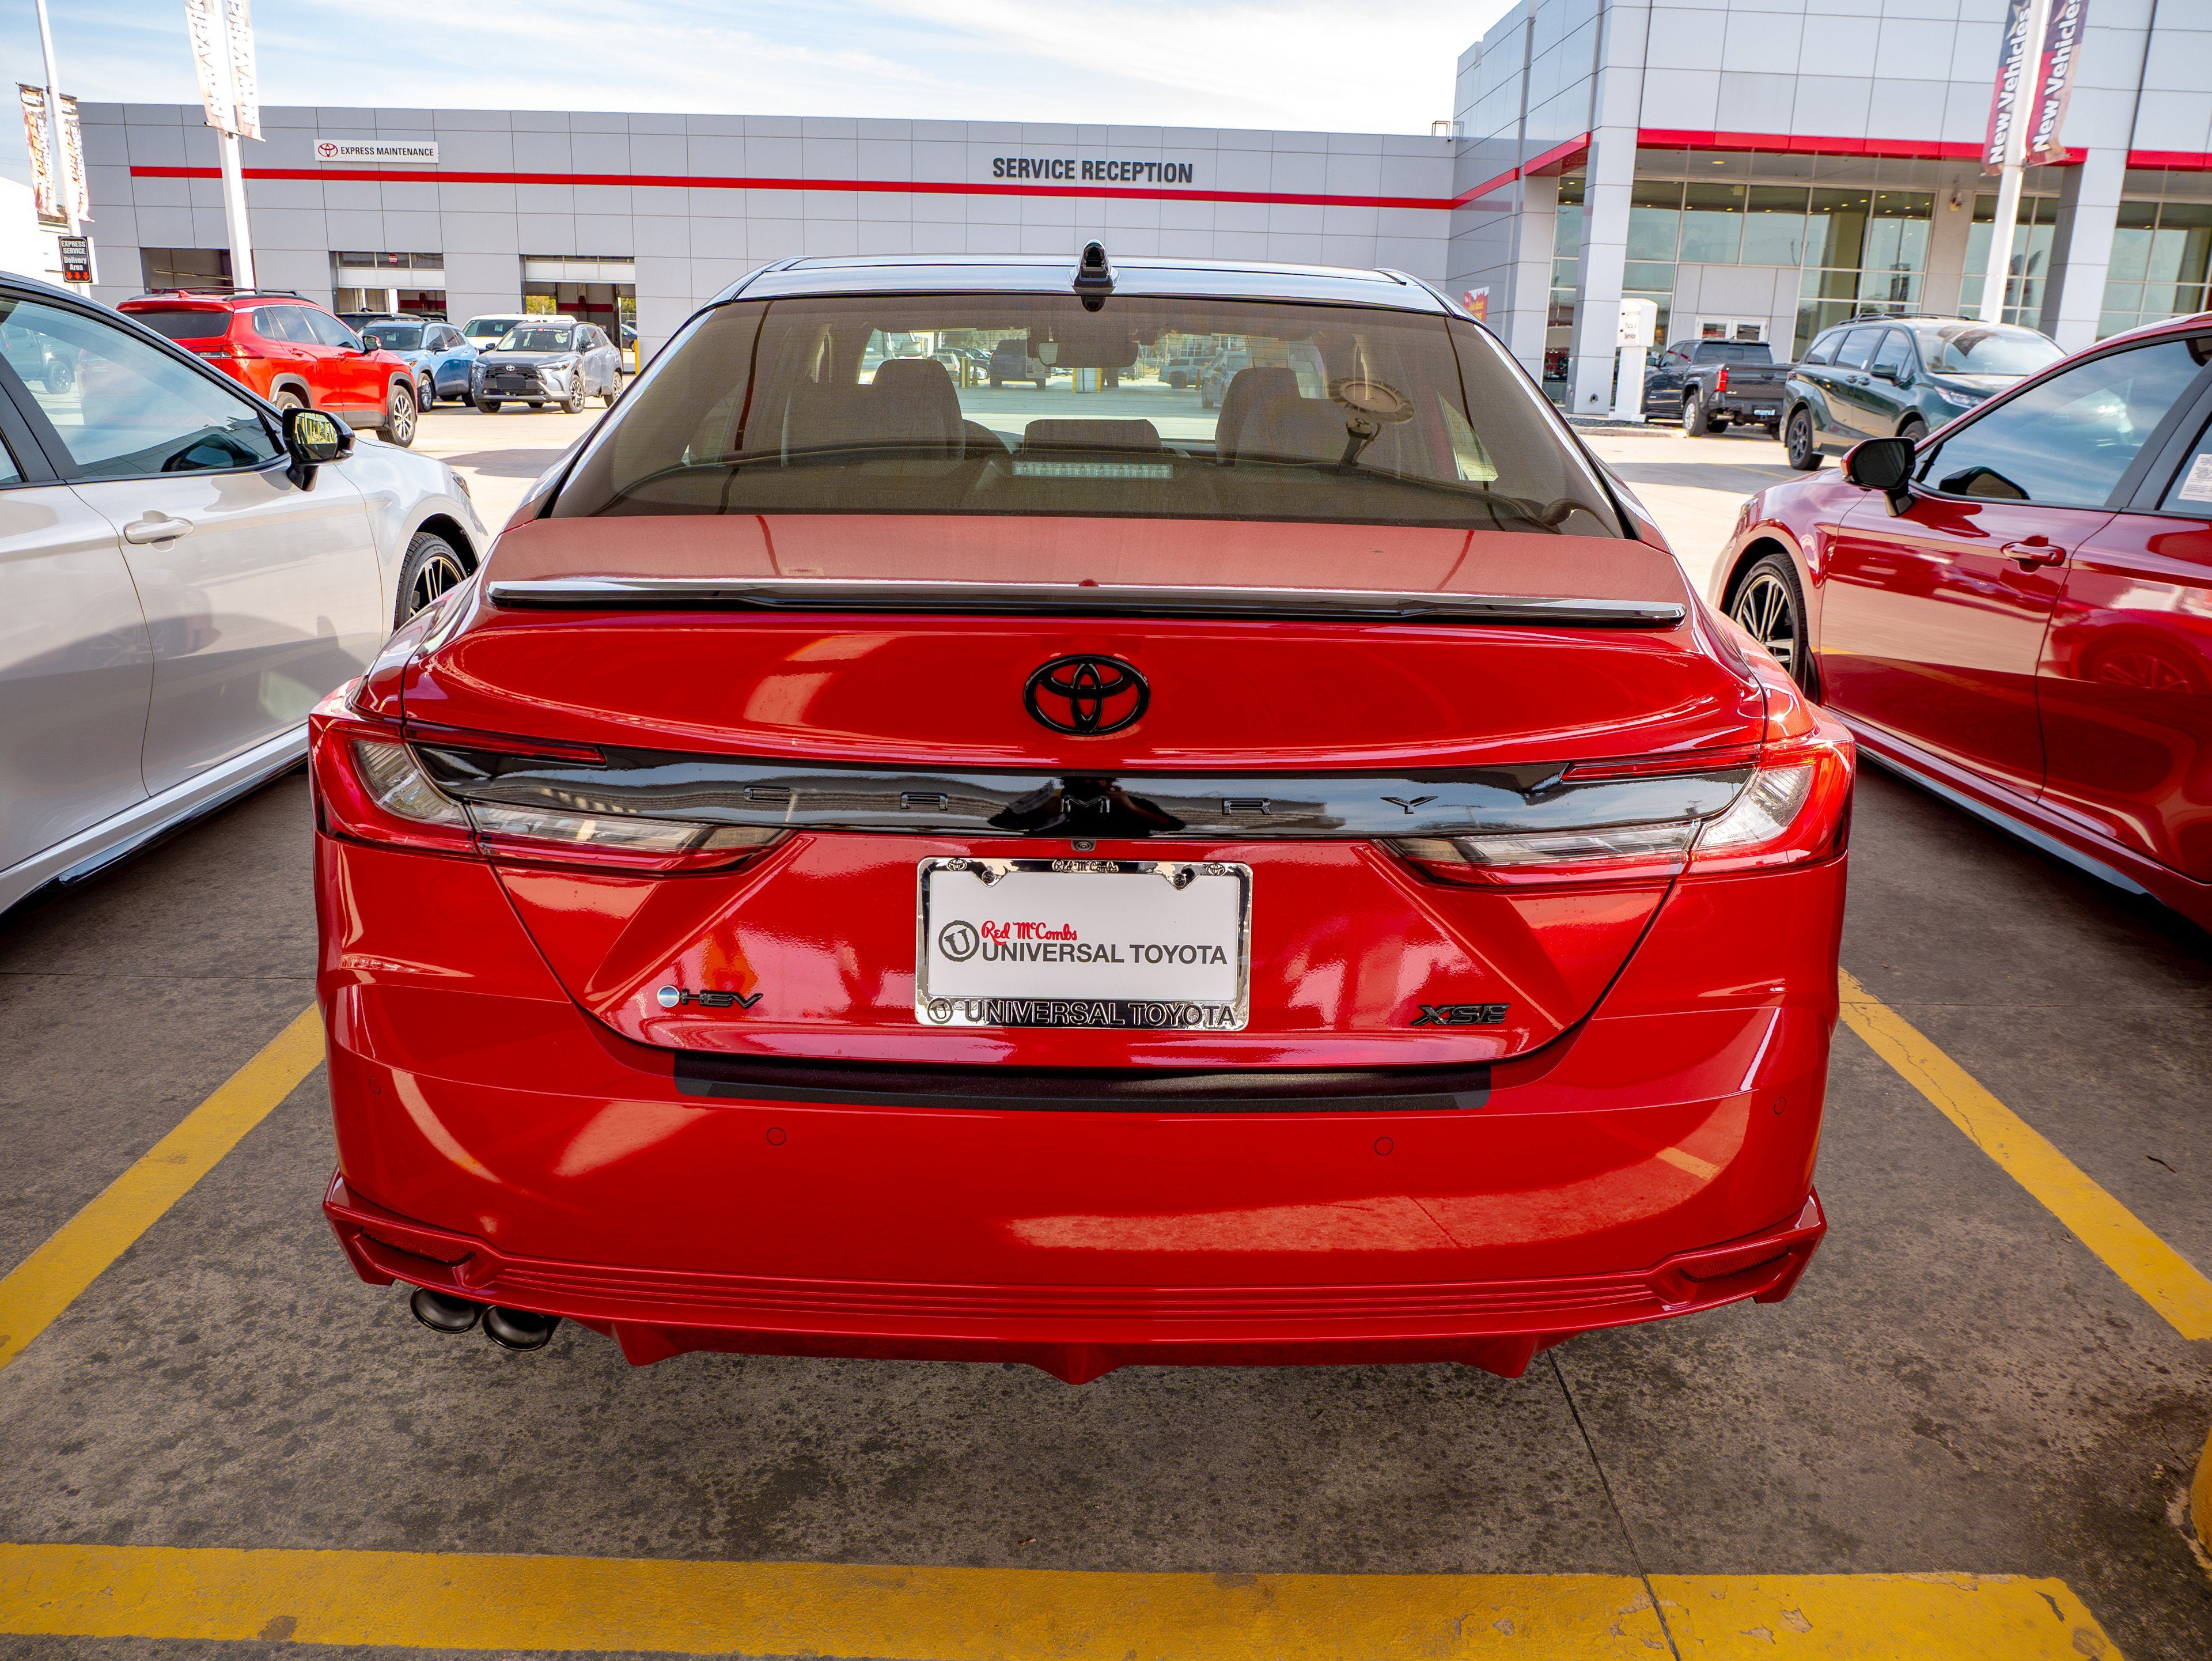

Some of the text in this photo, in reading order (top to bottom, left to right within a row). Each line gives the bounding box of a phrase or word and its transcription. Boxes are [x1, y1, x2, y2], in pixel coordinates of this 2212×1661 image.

[1989, 7, 2031, 165] New Vehicles
[2032, 0, 2081, 153] New Vehicle
[340, 146, 434, 157] EXPRESS MAINTENANCE
[993, 157, 1194, 183] SERVICE RECEPTION
[64, 256, 86, 265] Delivery
[1052, 859, 1074, 873] Red
[981, 921, 1078, 946] Red McCombs
[982, 942, 1228, 965] UNIVERSAL TOYOTA
[964, 999, 1125, 1026] UNIVERSAL
[1128, 1002, 1237, 1027] TOYOTA
[1410, 1003, 1510, 1026] XSE
